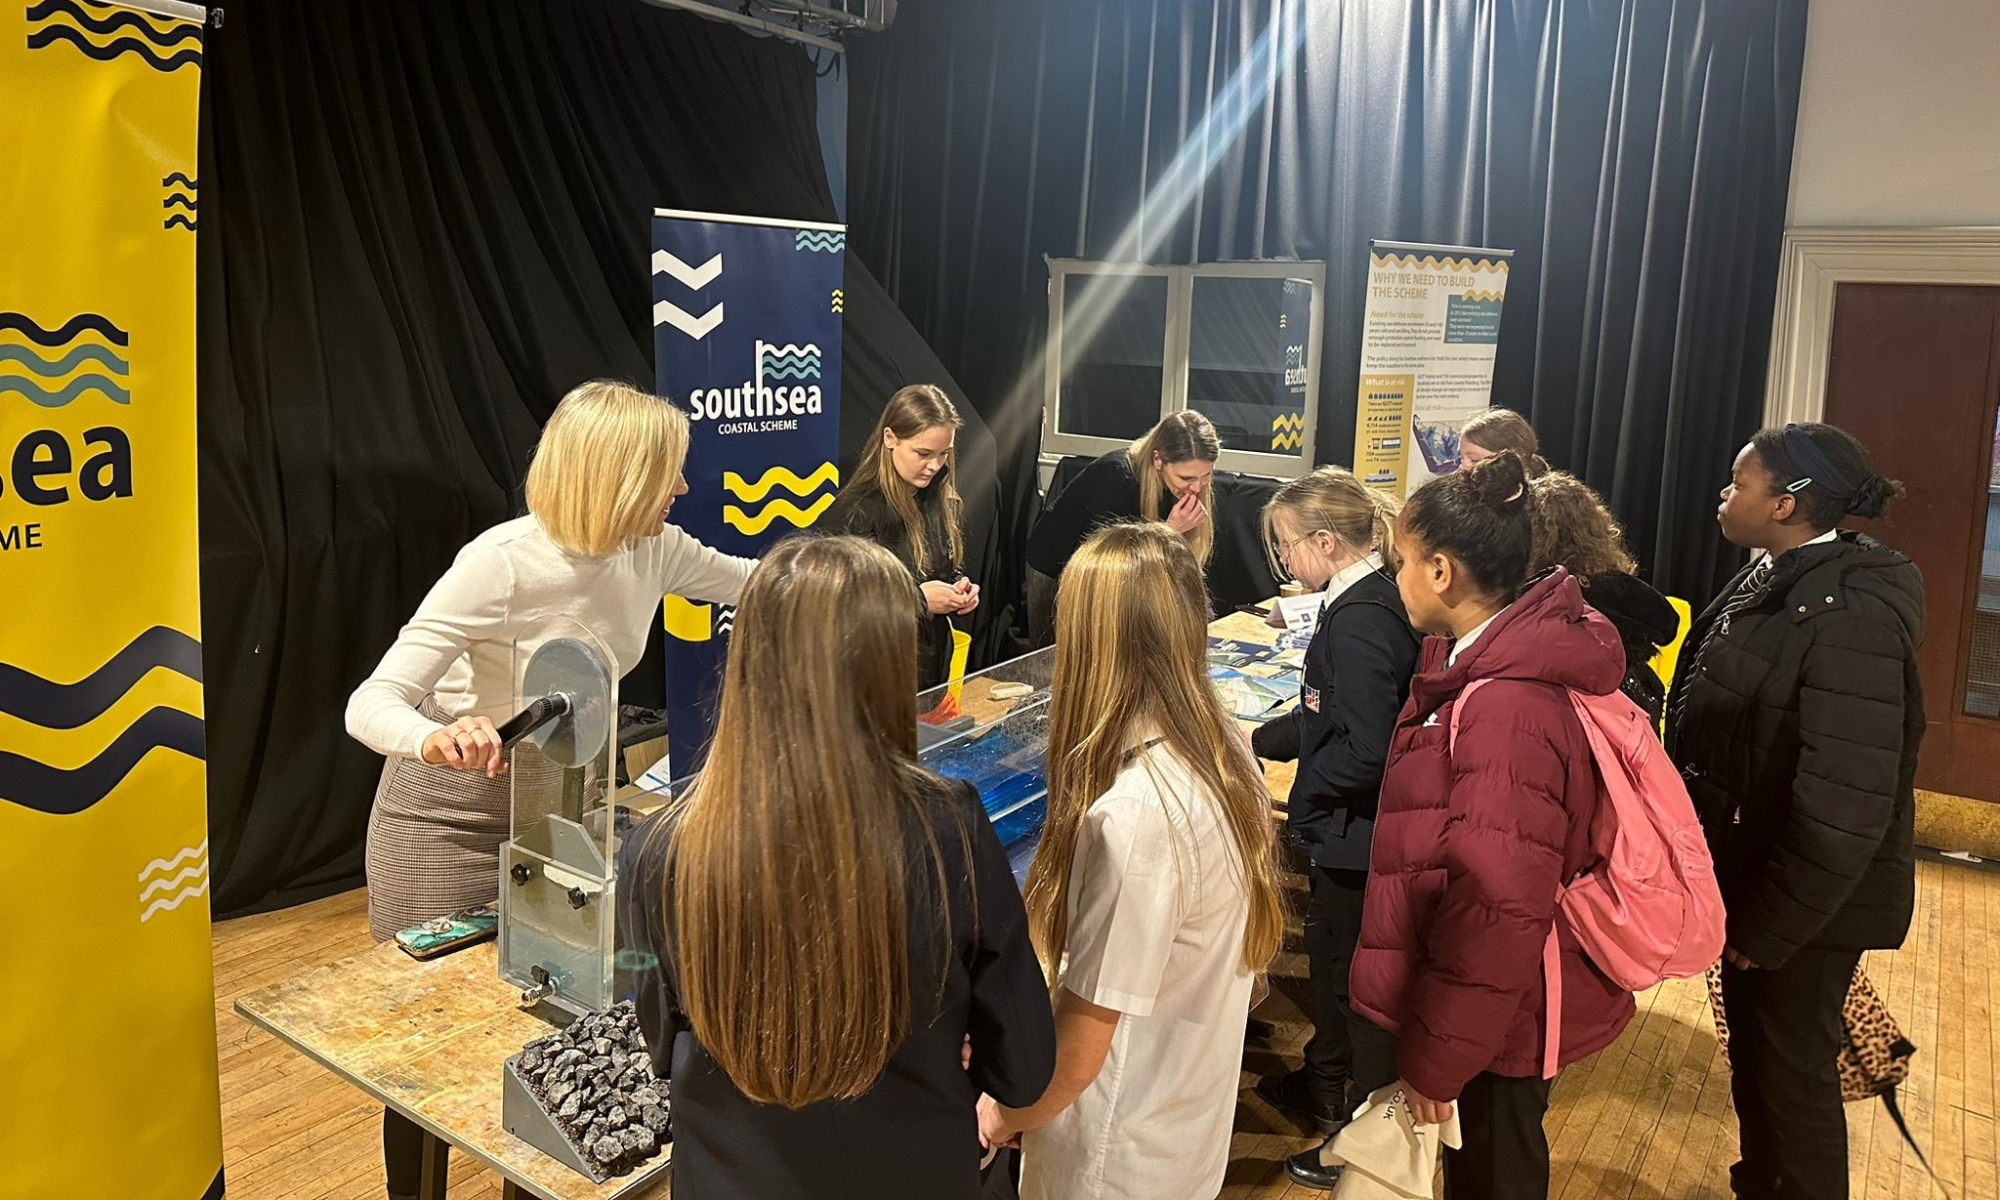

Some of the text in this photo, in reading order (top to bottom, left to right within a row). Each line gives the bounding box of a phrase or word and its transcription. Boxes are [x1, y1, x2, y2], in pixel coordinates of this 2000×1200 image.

[1373, 272, 1475, 287] WHY WE NEED TO BUILD
[1372, 286, 1428, 299] THE SCHEME
[1370, 310, 1388, 318] Need
[1389, 310, 1397, 318] for
[690, 340, 822, 421] southsea
[1365, 378, 1384, 386] What
[718, 420, 798, 435] COASTAL SCHEME
[0, 425, 133, 506] ea
